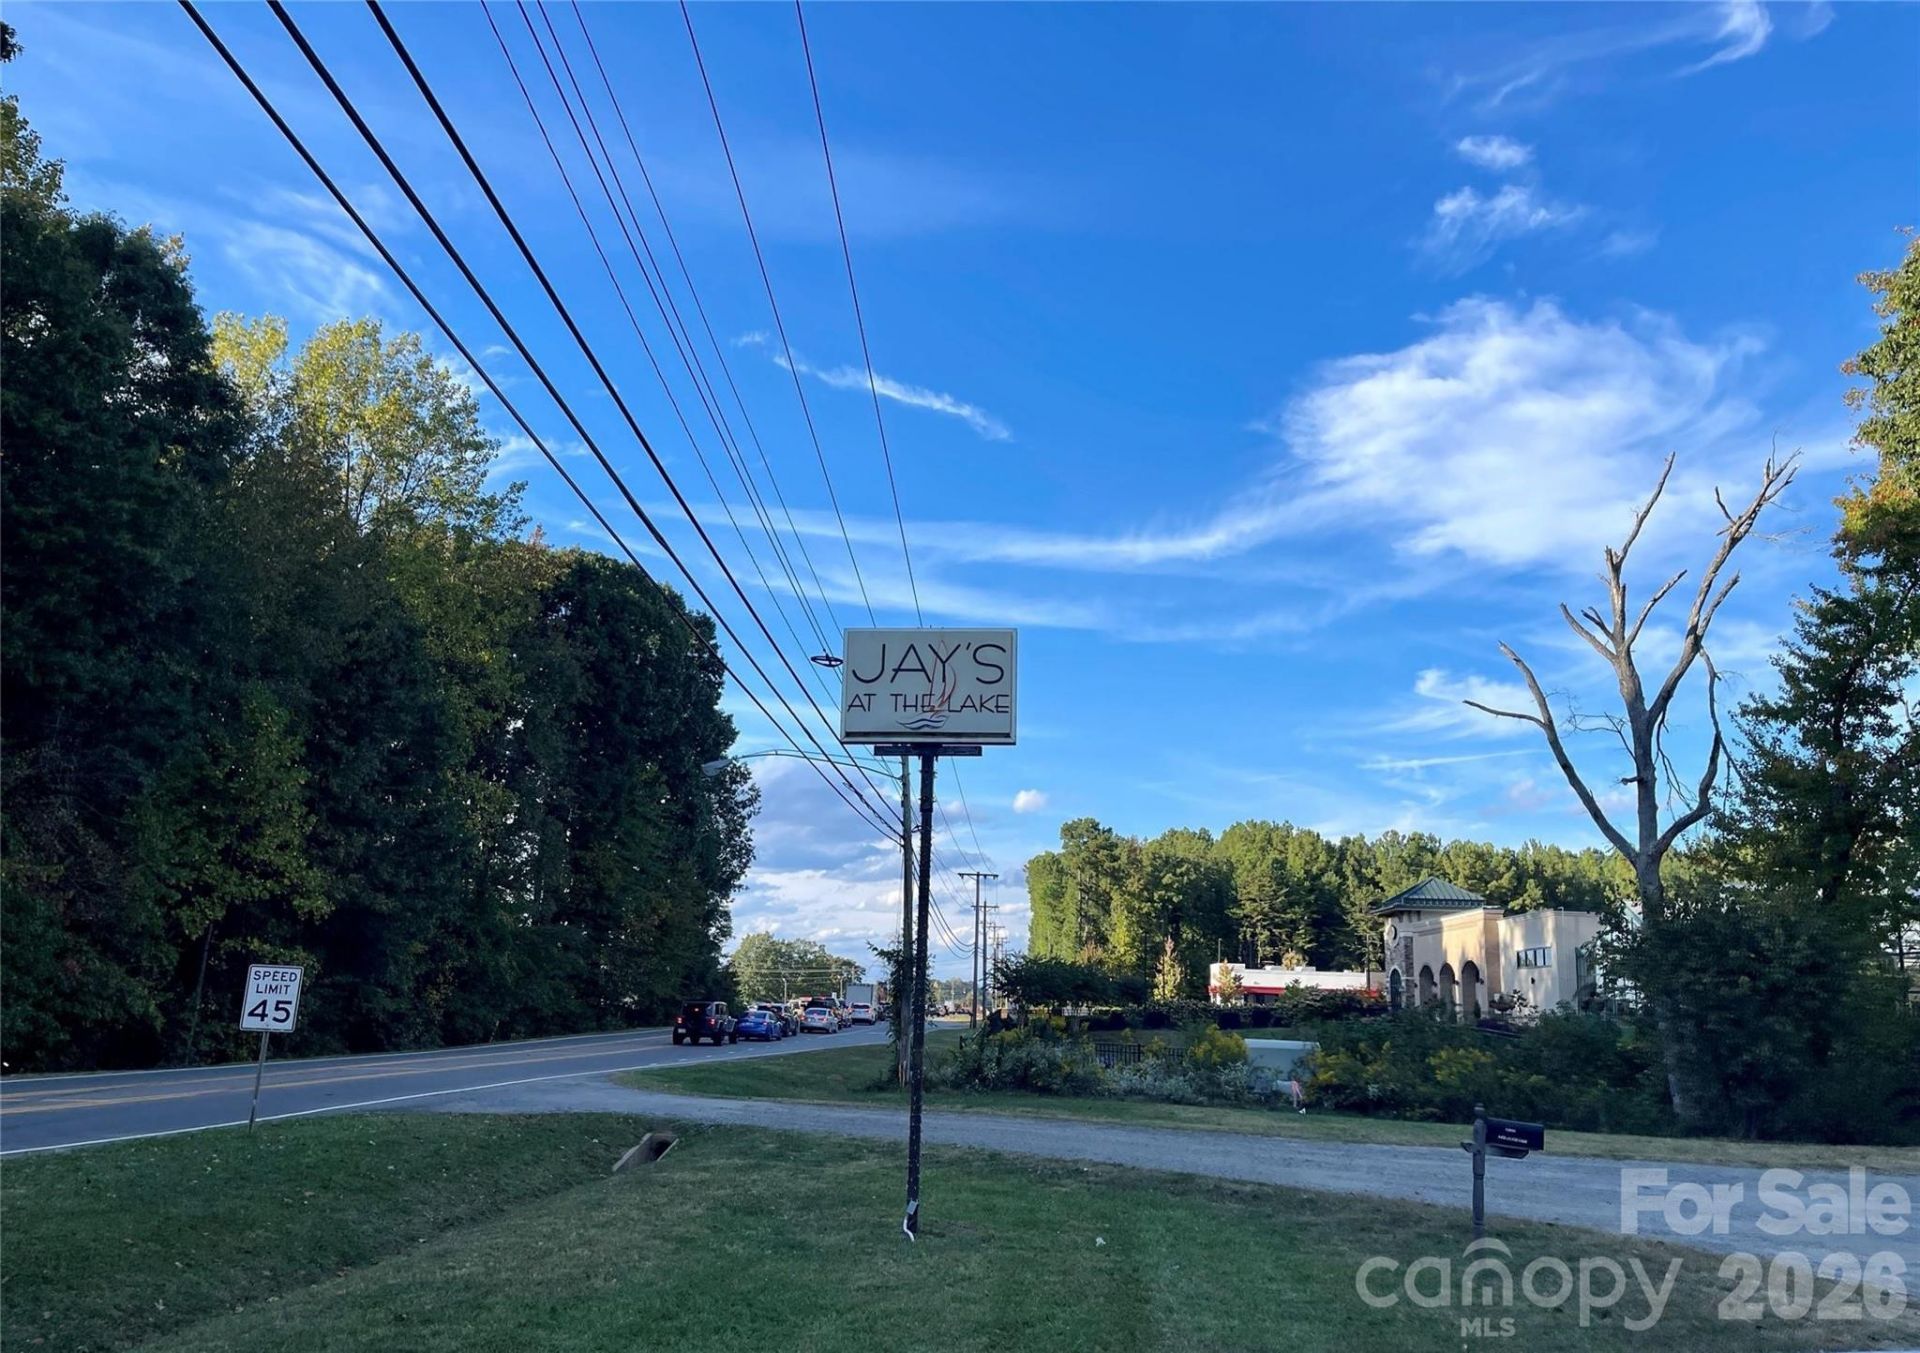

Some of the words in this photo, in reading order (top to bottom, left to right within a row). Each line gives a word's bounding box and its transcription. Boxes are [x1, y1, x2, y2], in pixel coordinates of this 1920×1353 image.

[852, 642, 1006, 685] JAY'S
[847, 694, 876, 713] AT
[890, 693, 935, 713] THE
[948, 694, 1010, 714] LAKE
[253, 970, 298, 983] SPEED
[256, 984, 291, 995] LIMIT
[247, 999, 293, 1023] 45
